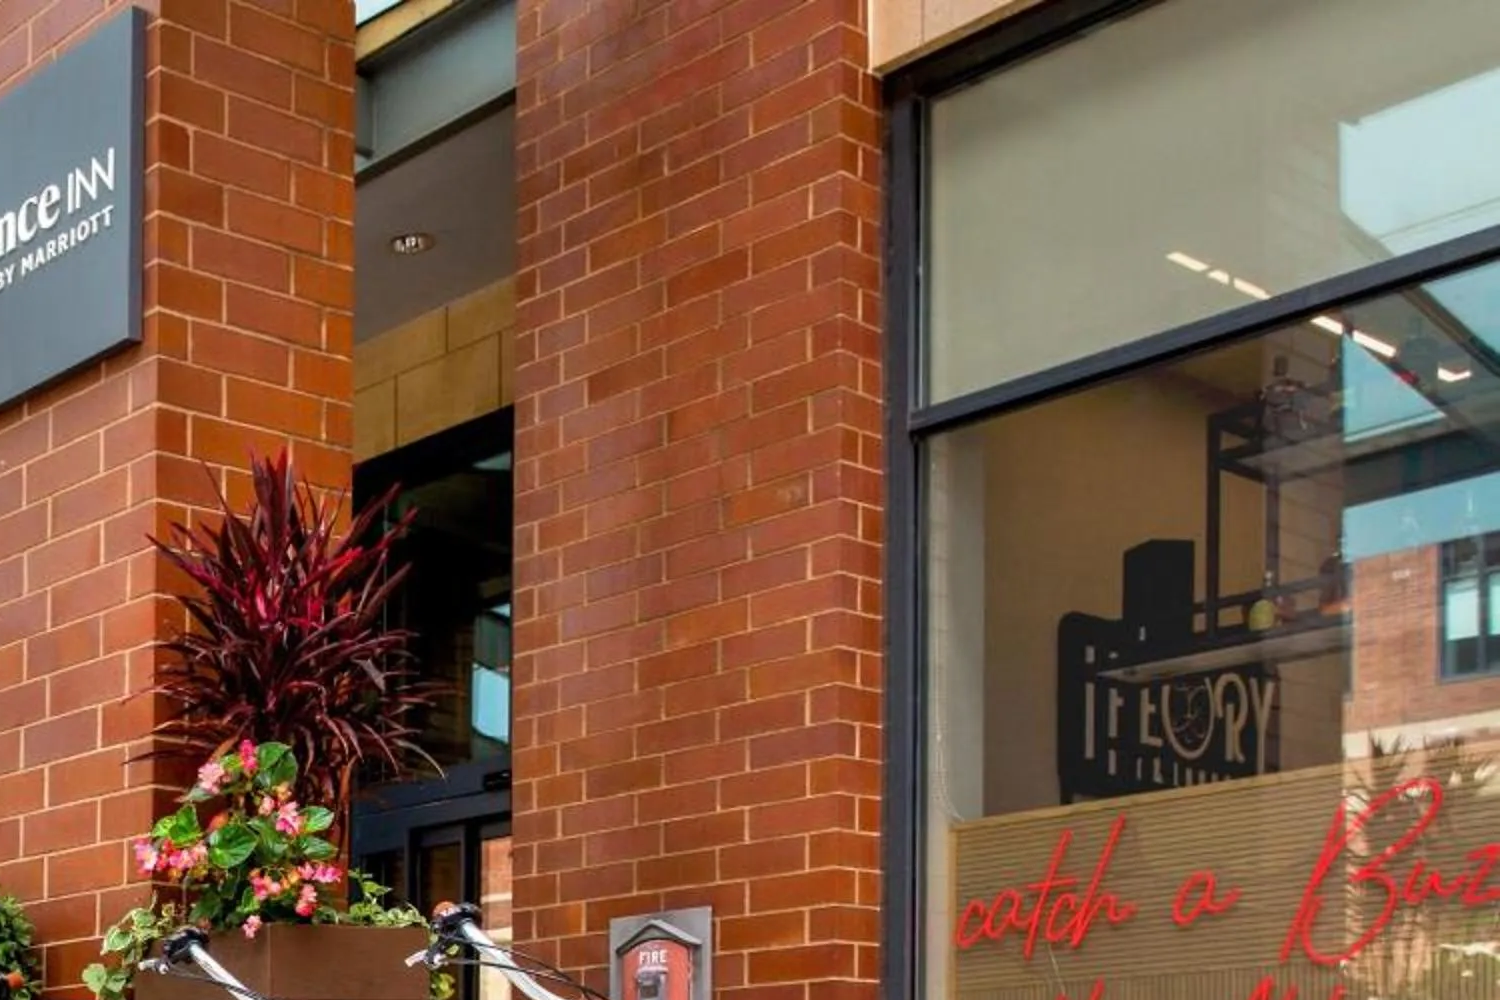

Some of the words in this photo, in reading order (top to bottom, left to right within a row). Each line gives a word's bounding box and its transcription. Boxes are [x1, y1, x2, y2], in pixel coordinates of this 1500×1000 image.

[67, 147, 115, 213] INN
[21, 204, 114, 276] MARRIOTT
[955, 811, 1138, 961] catch
[1171, 867, 1242, 925] a
[639, 949, 668, 965] FIRE
